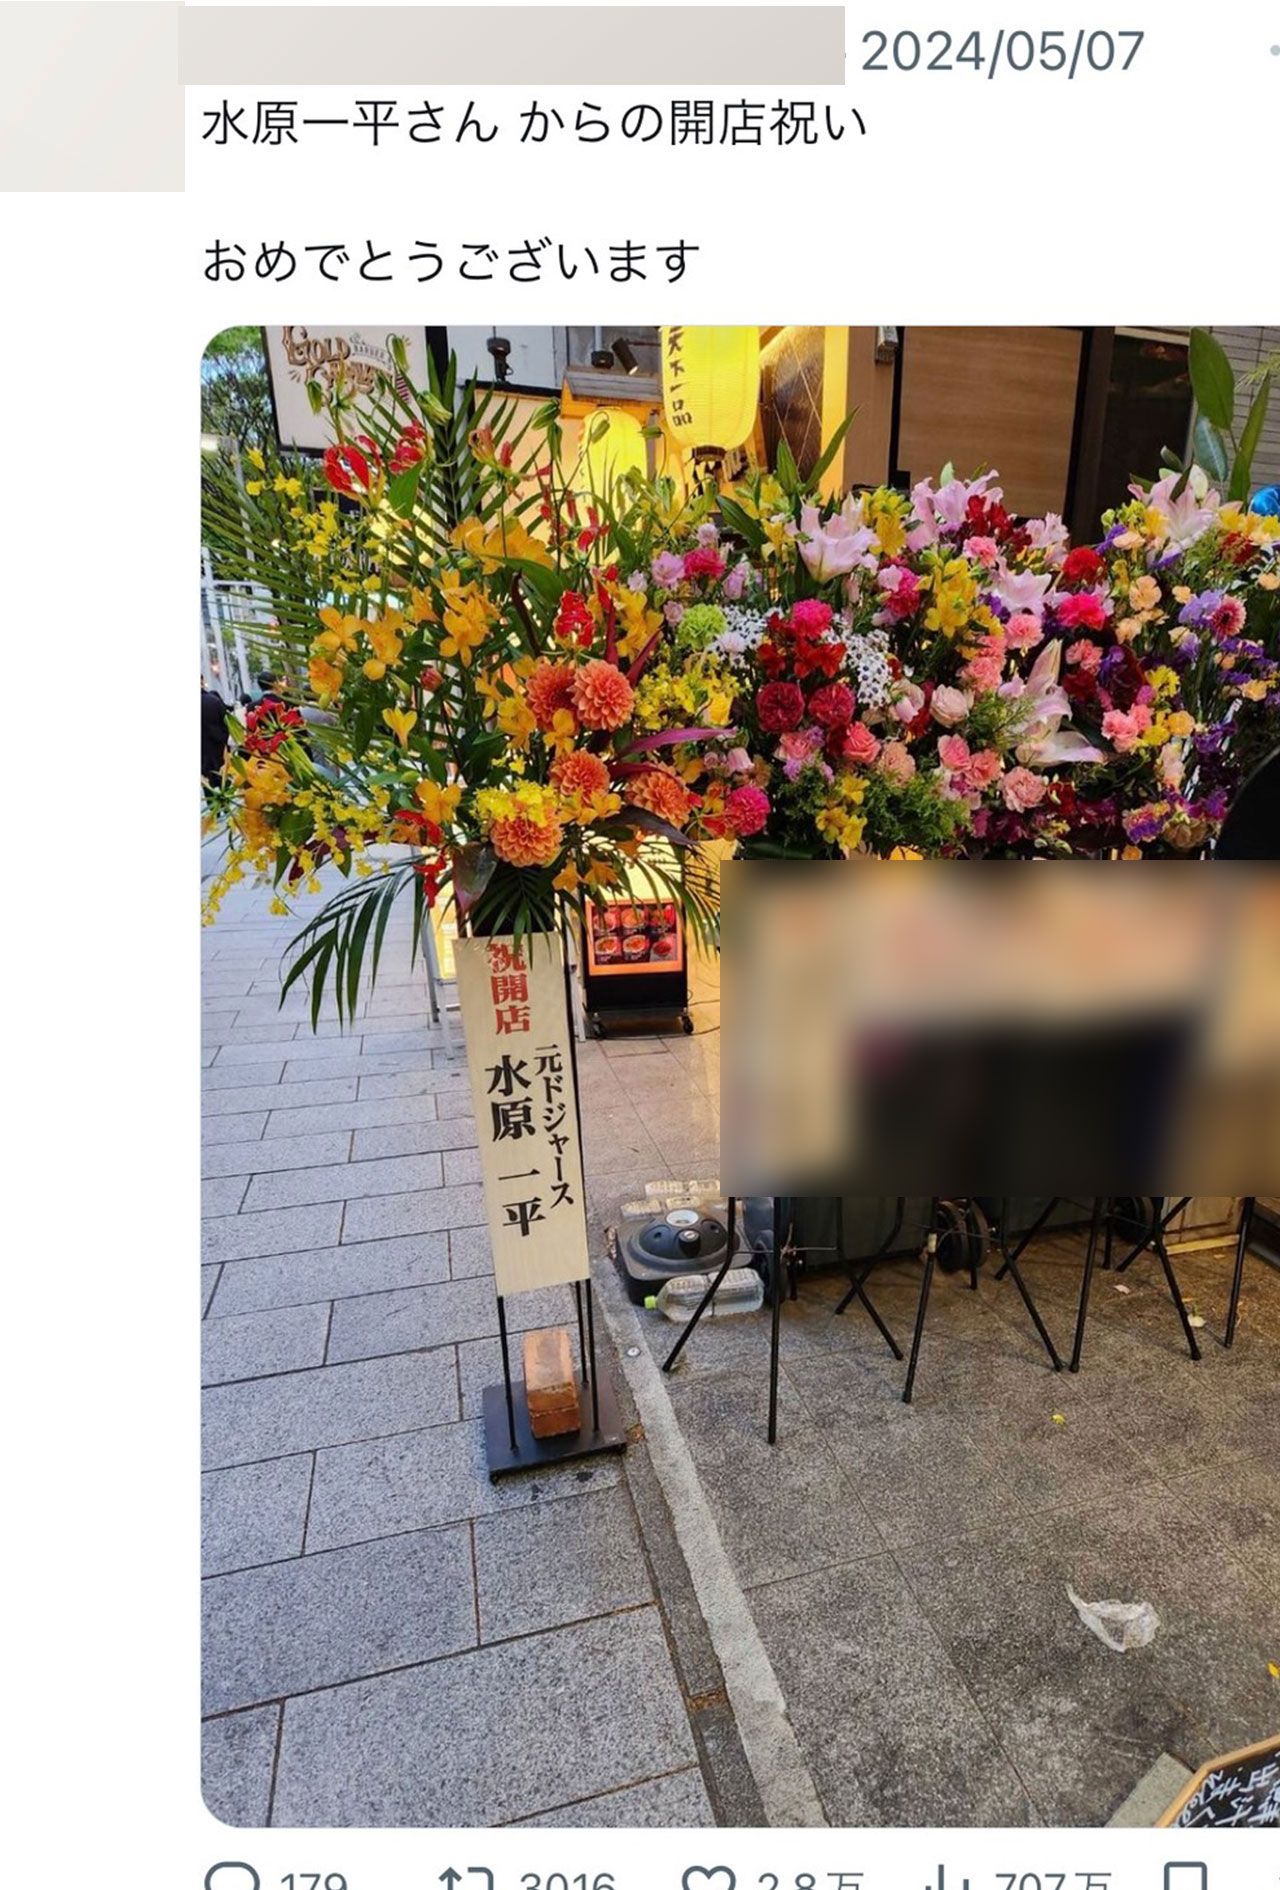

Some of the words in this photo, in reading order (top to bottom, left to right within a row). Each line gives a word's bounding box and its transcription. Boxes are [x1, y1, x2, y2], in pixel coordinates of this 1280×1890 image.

[535, 1044, 574, 1209] 元ドジャース
